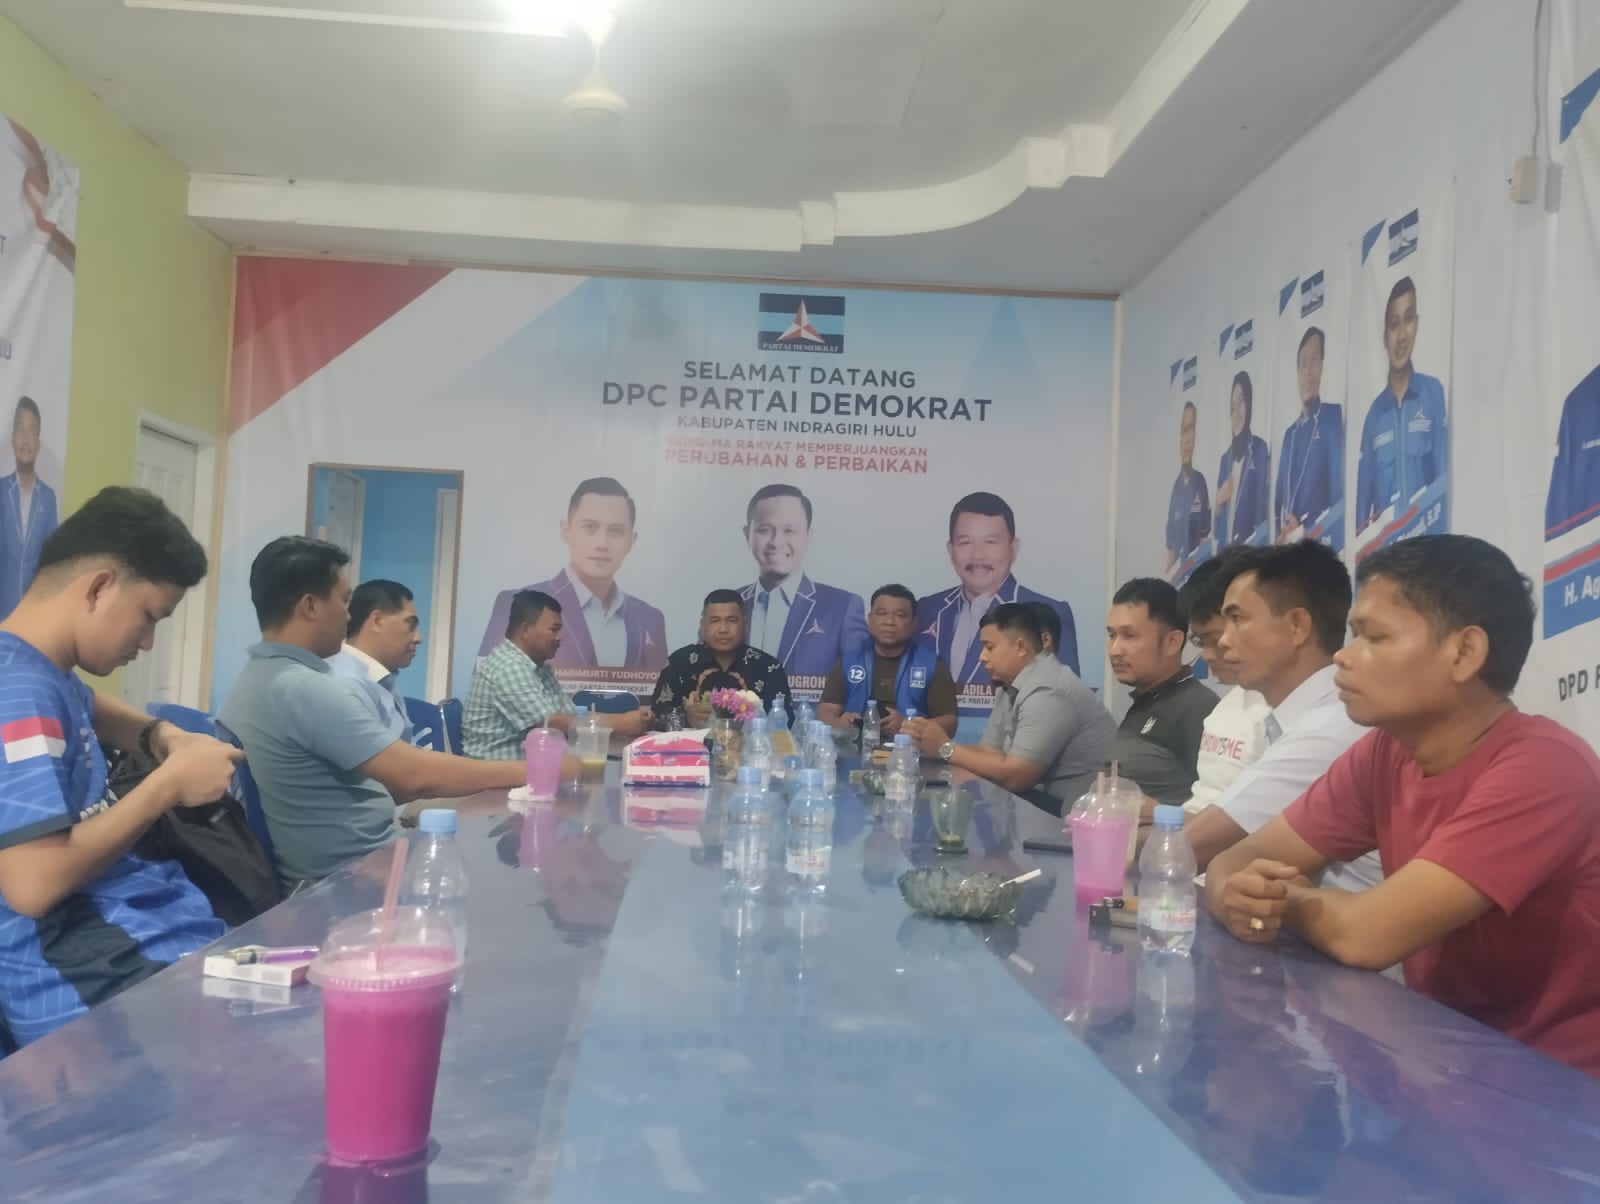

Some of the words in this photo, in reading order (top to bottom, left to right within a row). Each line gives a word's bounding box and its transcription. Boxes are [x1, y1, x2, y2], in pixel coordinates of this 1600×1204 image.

[684, 361, 802, 383] SELAMAT
[810, 367, 915, 388] DATANG
[602, 381, 668, 407] DPC
[680, 386, 798, 414] PARTAI
[810, 391, 992, 421] DEMOKRAT
[677, 415, 777, 432] KABUPATEN
[783, 421, 868, 436] INDRAGIRI
[873, 424, 917, 438] HULU
[736, 439, 793, 451] RAKYAT
[796, 442, 928, 457] MEMPERJUANGKAN
[795, 455, 806, 469] &
[814, 455, 928, 473] PERBAIKAN
[1564, 582, 1579, 608] H.
[611, 671, 660, 680] YUDHOYO
[850, 668, 864, 681] 12
[962, 684, 993, 697] ADILA
[1558, 669, 1588, 701] DPD
